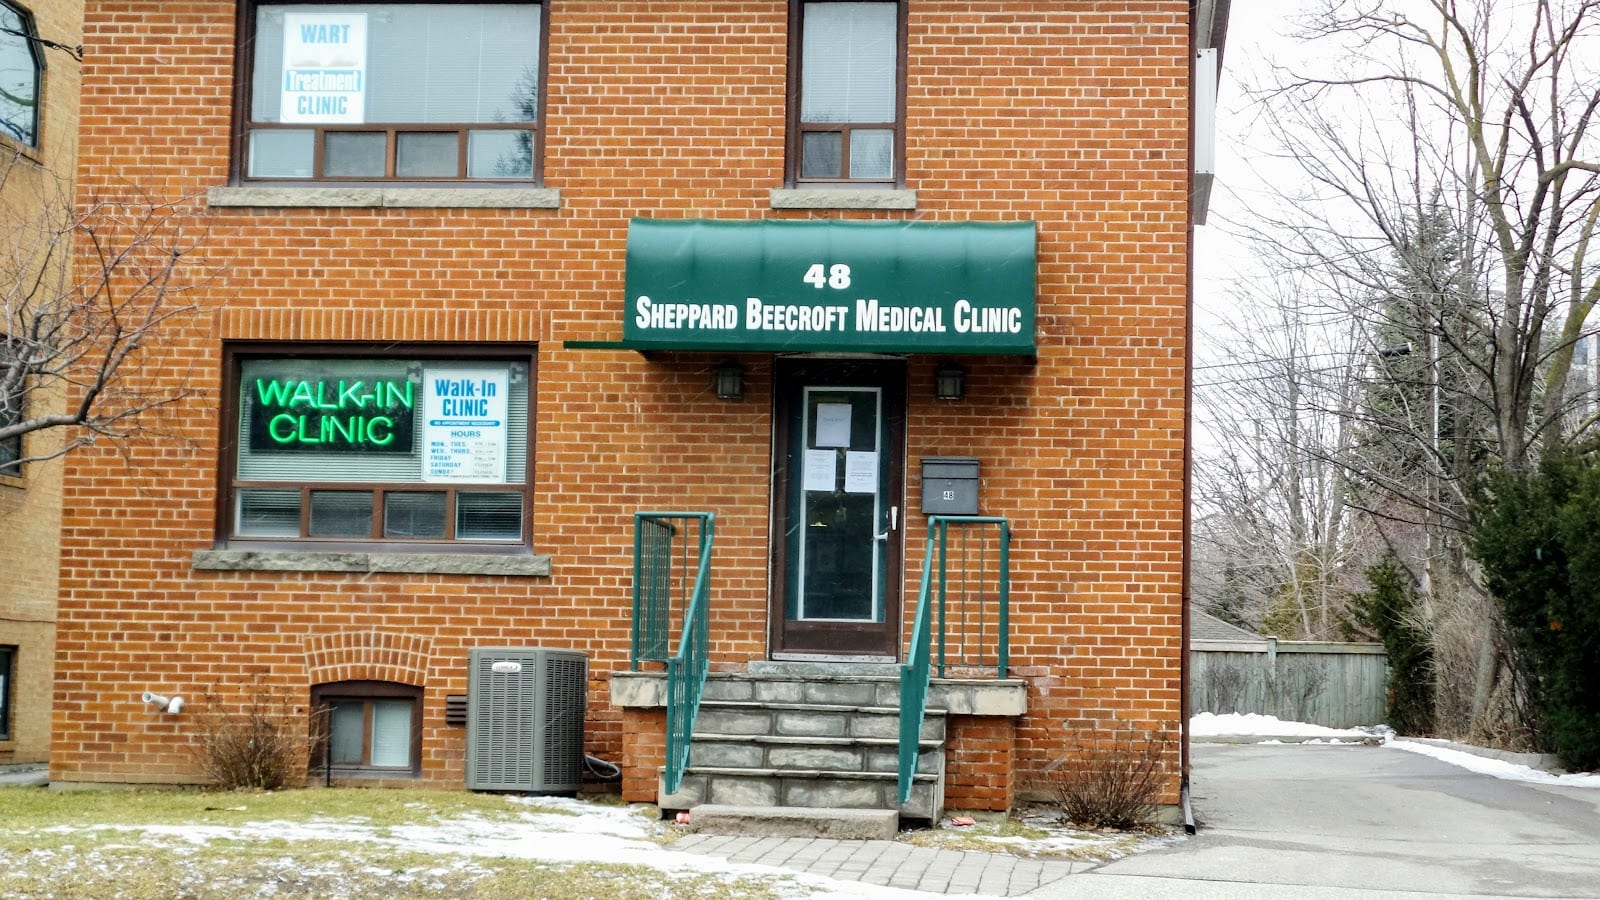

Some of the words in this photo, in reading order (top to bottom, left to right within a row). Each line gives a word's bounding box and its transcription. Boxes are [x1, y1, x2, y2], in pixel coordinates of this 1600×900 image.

[300, 24, 351, 44] WART
[288, 70, 359, 92] Treatment
[297, 95, 348, 115] CLINIC
[803, 263, 851, 289] 48
[635, 296, 738, 329] SHEPPARD
[745, 297, 849, 331] BEECROFT
[855, 299, 947, 332] MEDICAL
[953, 299, 1022, 333] CLINIC
[256, 378, 413, 409] WALK-IN
[434, 379, 496, 397] Walk-In
[442, 398, 488, 417] CLINIC
[269, 413, 394, 445] CLINIC
[943, 490, 954, 500] 48
